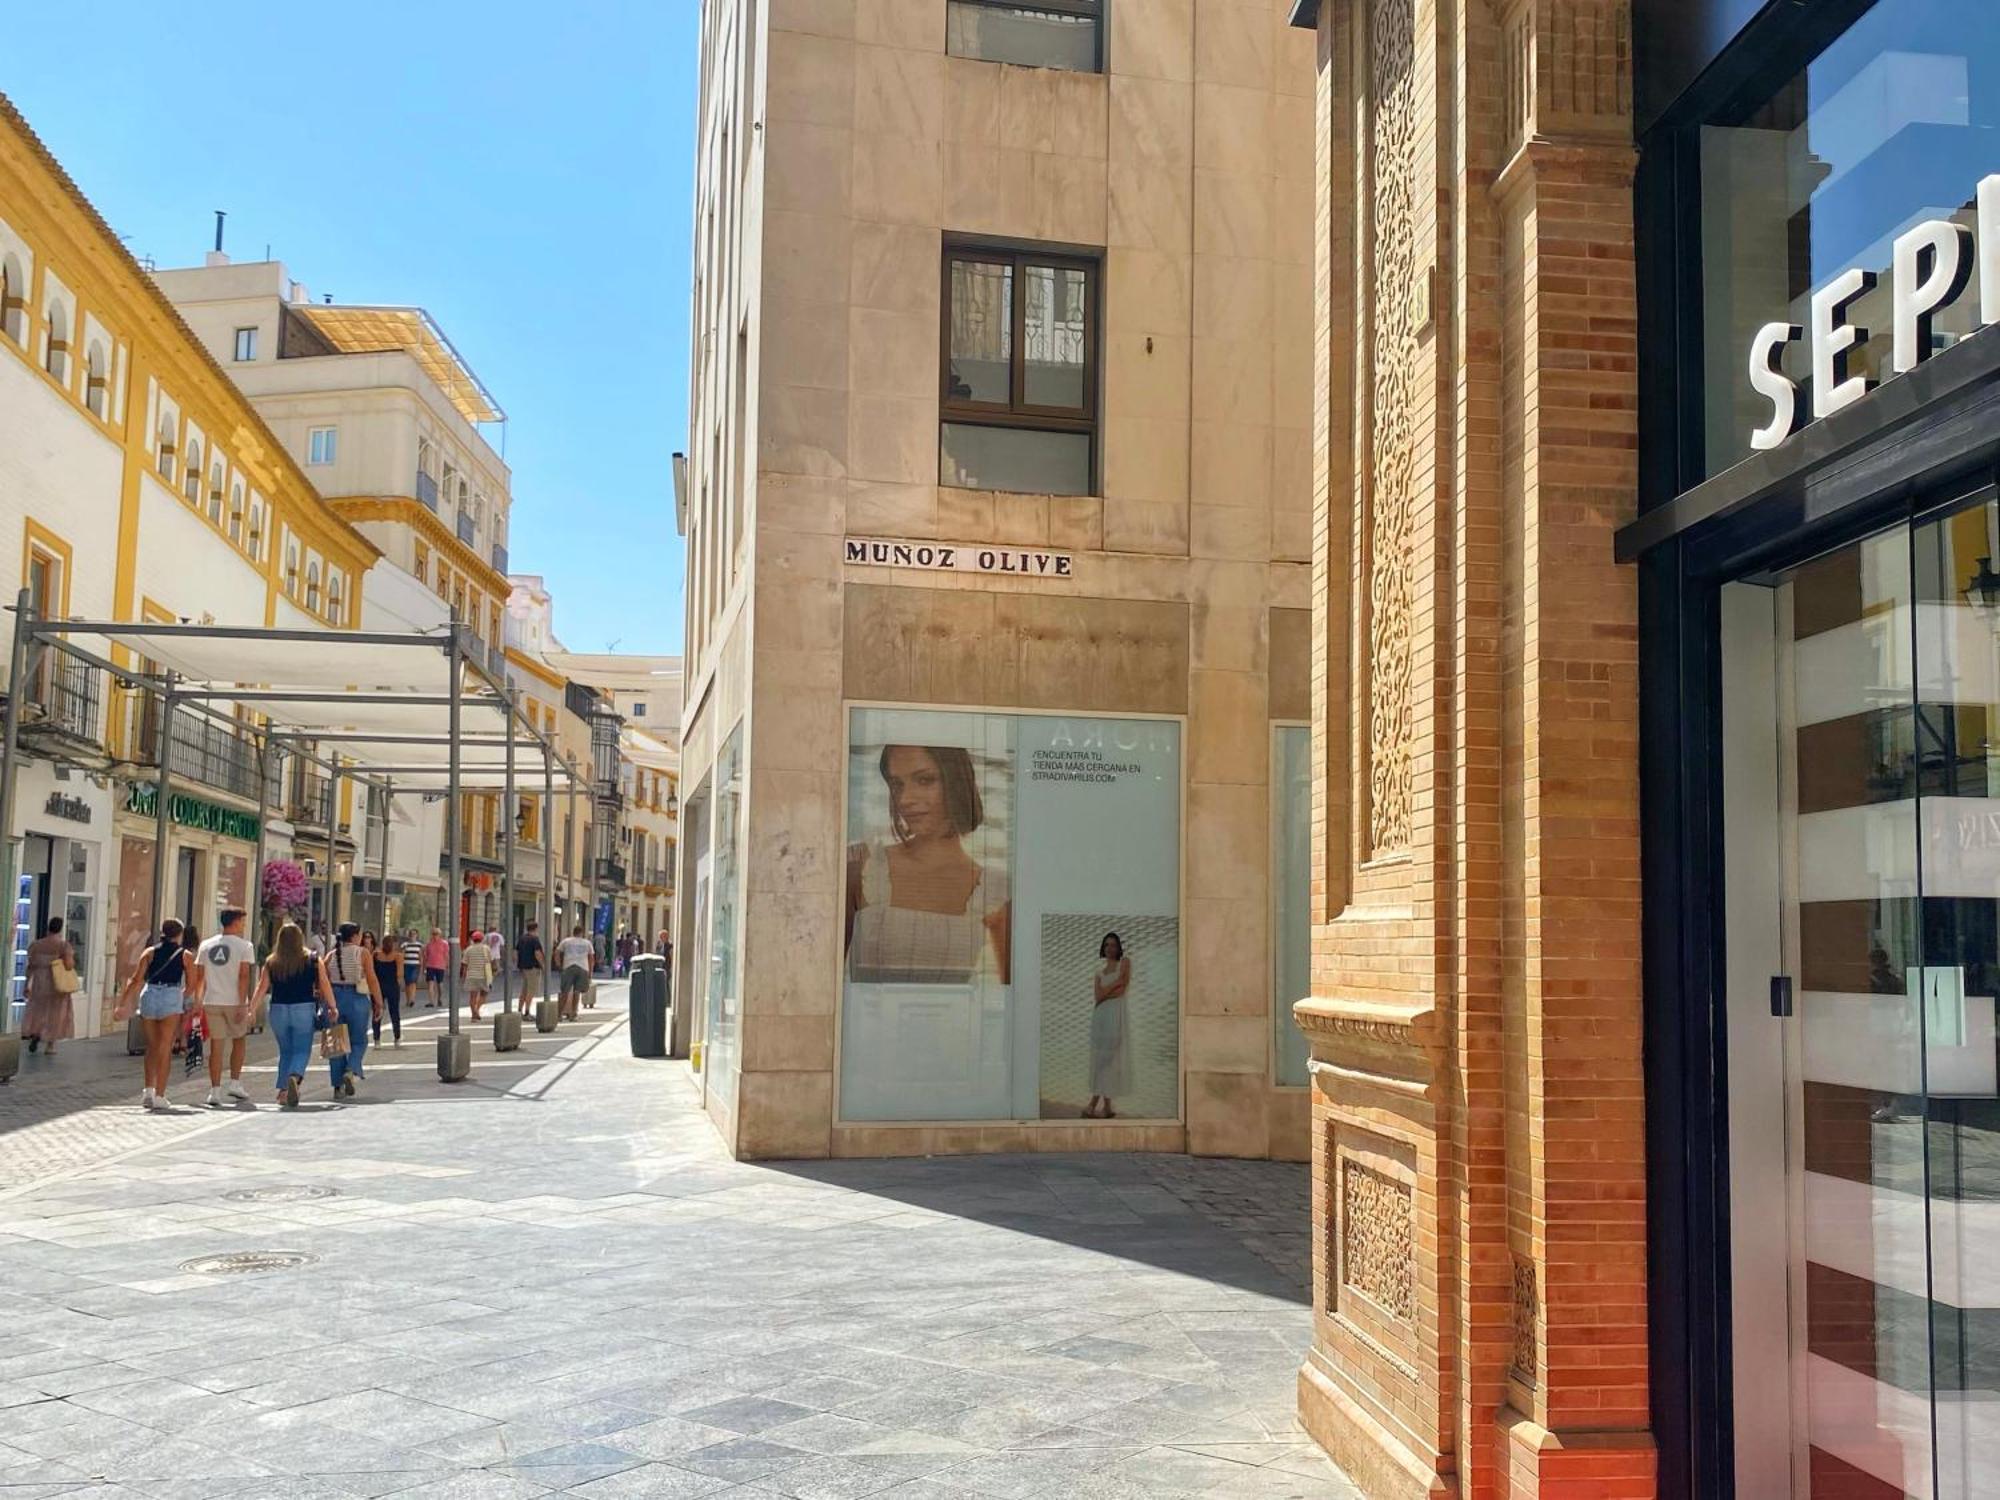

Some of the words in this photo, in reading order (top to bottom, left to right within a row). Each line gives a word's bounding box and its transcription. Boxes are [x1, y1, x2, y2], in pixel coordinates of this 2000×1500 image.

[847, 542, 955, 567] MUÑOZ
[979, 551, 1071, 575] OLIVE
[1086, 763, 1128, 773] CERCANA
[1129, 764, 1141, 775] EN
